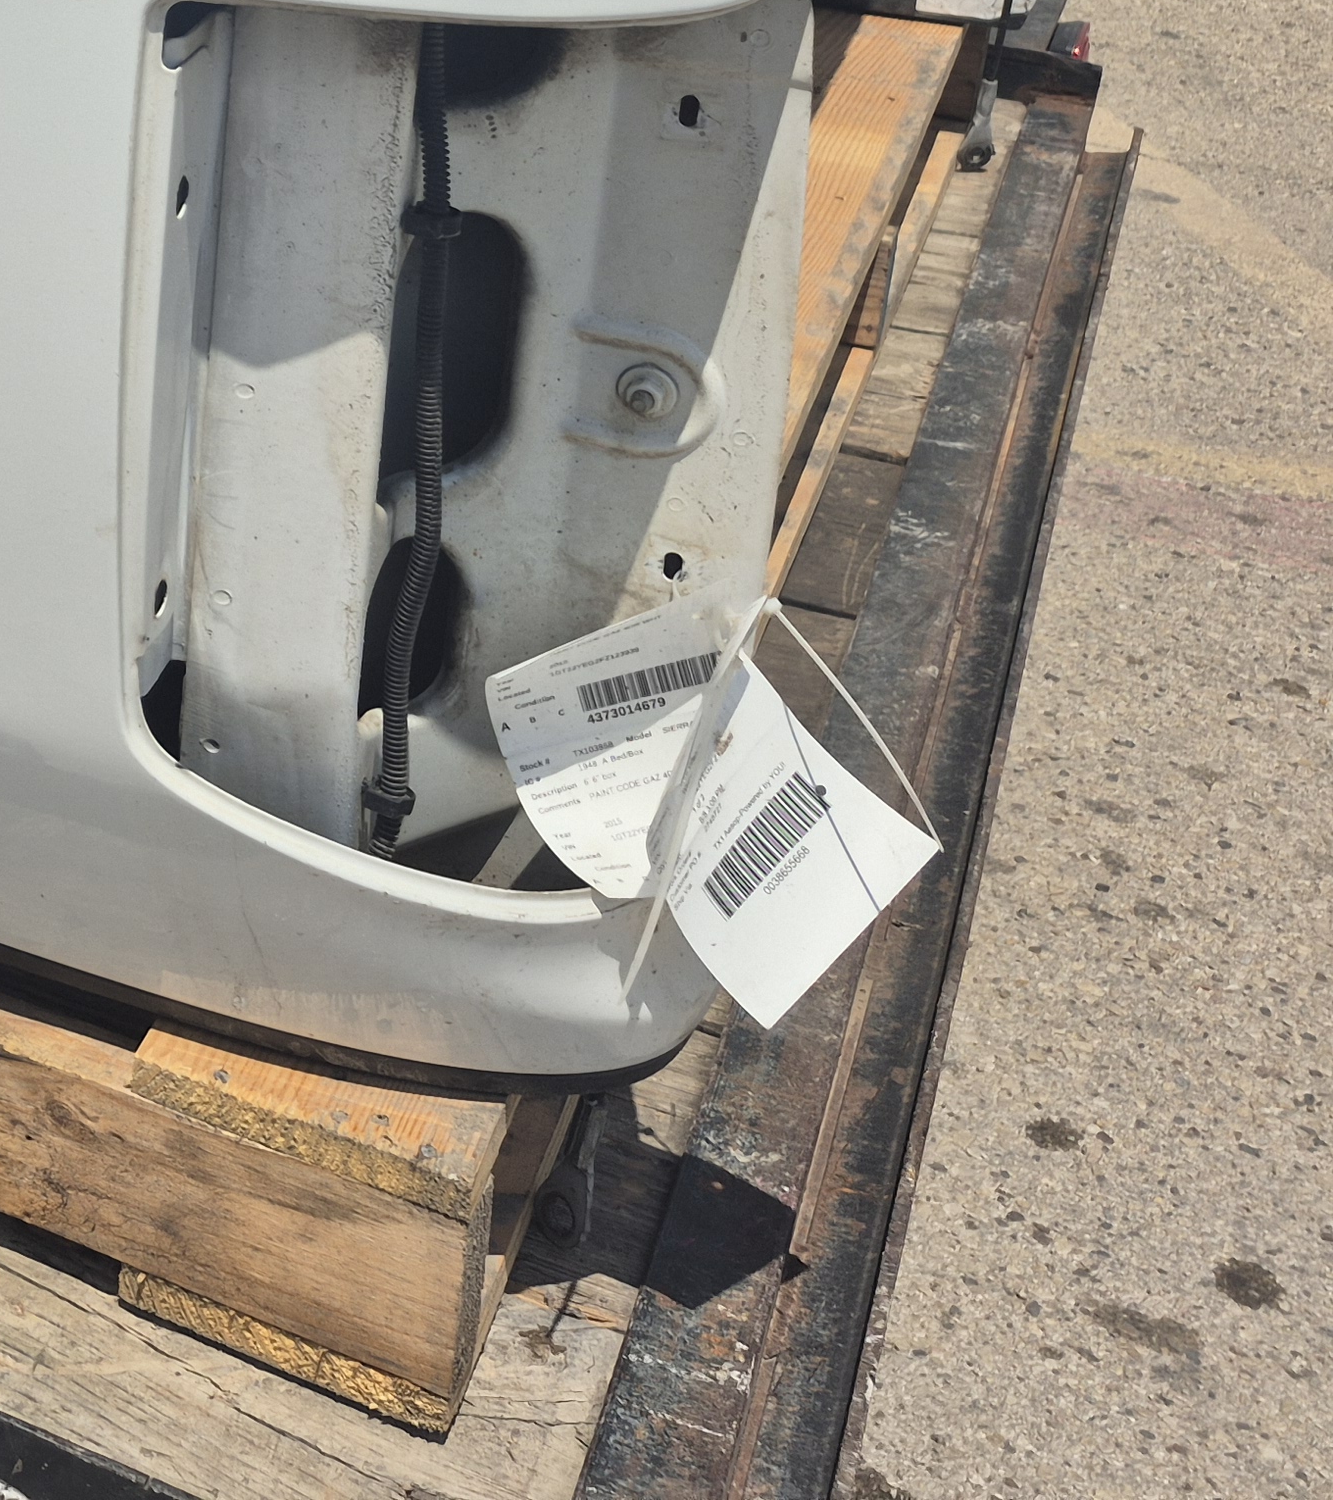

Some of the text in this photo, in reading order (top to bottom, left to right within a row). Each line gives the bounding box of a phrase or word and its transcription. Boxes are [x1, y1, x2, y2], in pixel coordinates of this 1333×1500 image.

[497, 687, 532, 702] Located
[514, 694, 556, 711] Condition
[500, 722, 511, 732] A
[558, 708, 566, 717] C
[586, 697, 666, 725] 4373014679
[519, 760, 544, 772] Stock
[625, 730, 653, 744] Model
[530, 781, 578, 801] Description
[537, 799, 582, 815] Comments
[588, 786, 616, 801] PAINT
[616, 780, 641, 794] CODE
[643, 773, 661, 786] GAZ
[723, 788, 765, 837] Aesop-Powered
[762, 778, 772, 792] by
[768, 760, 787, 781] YOU!
[762, 845, 811, 895] 0038655668
